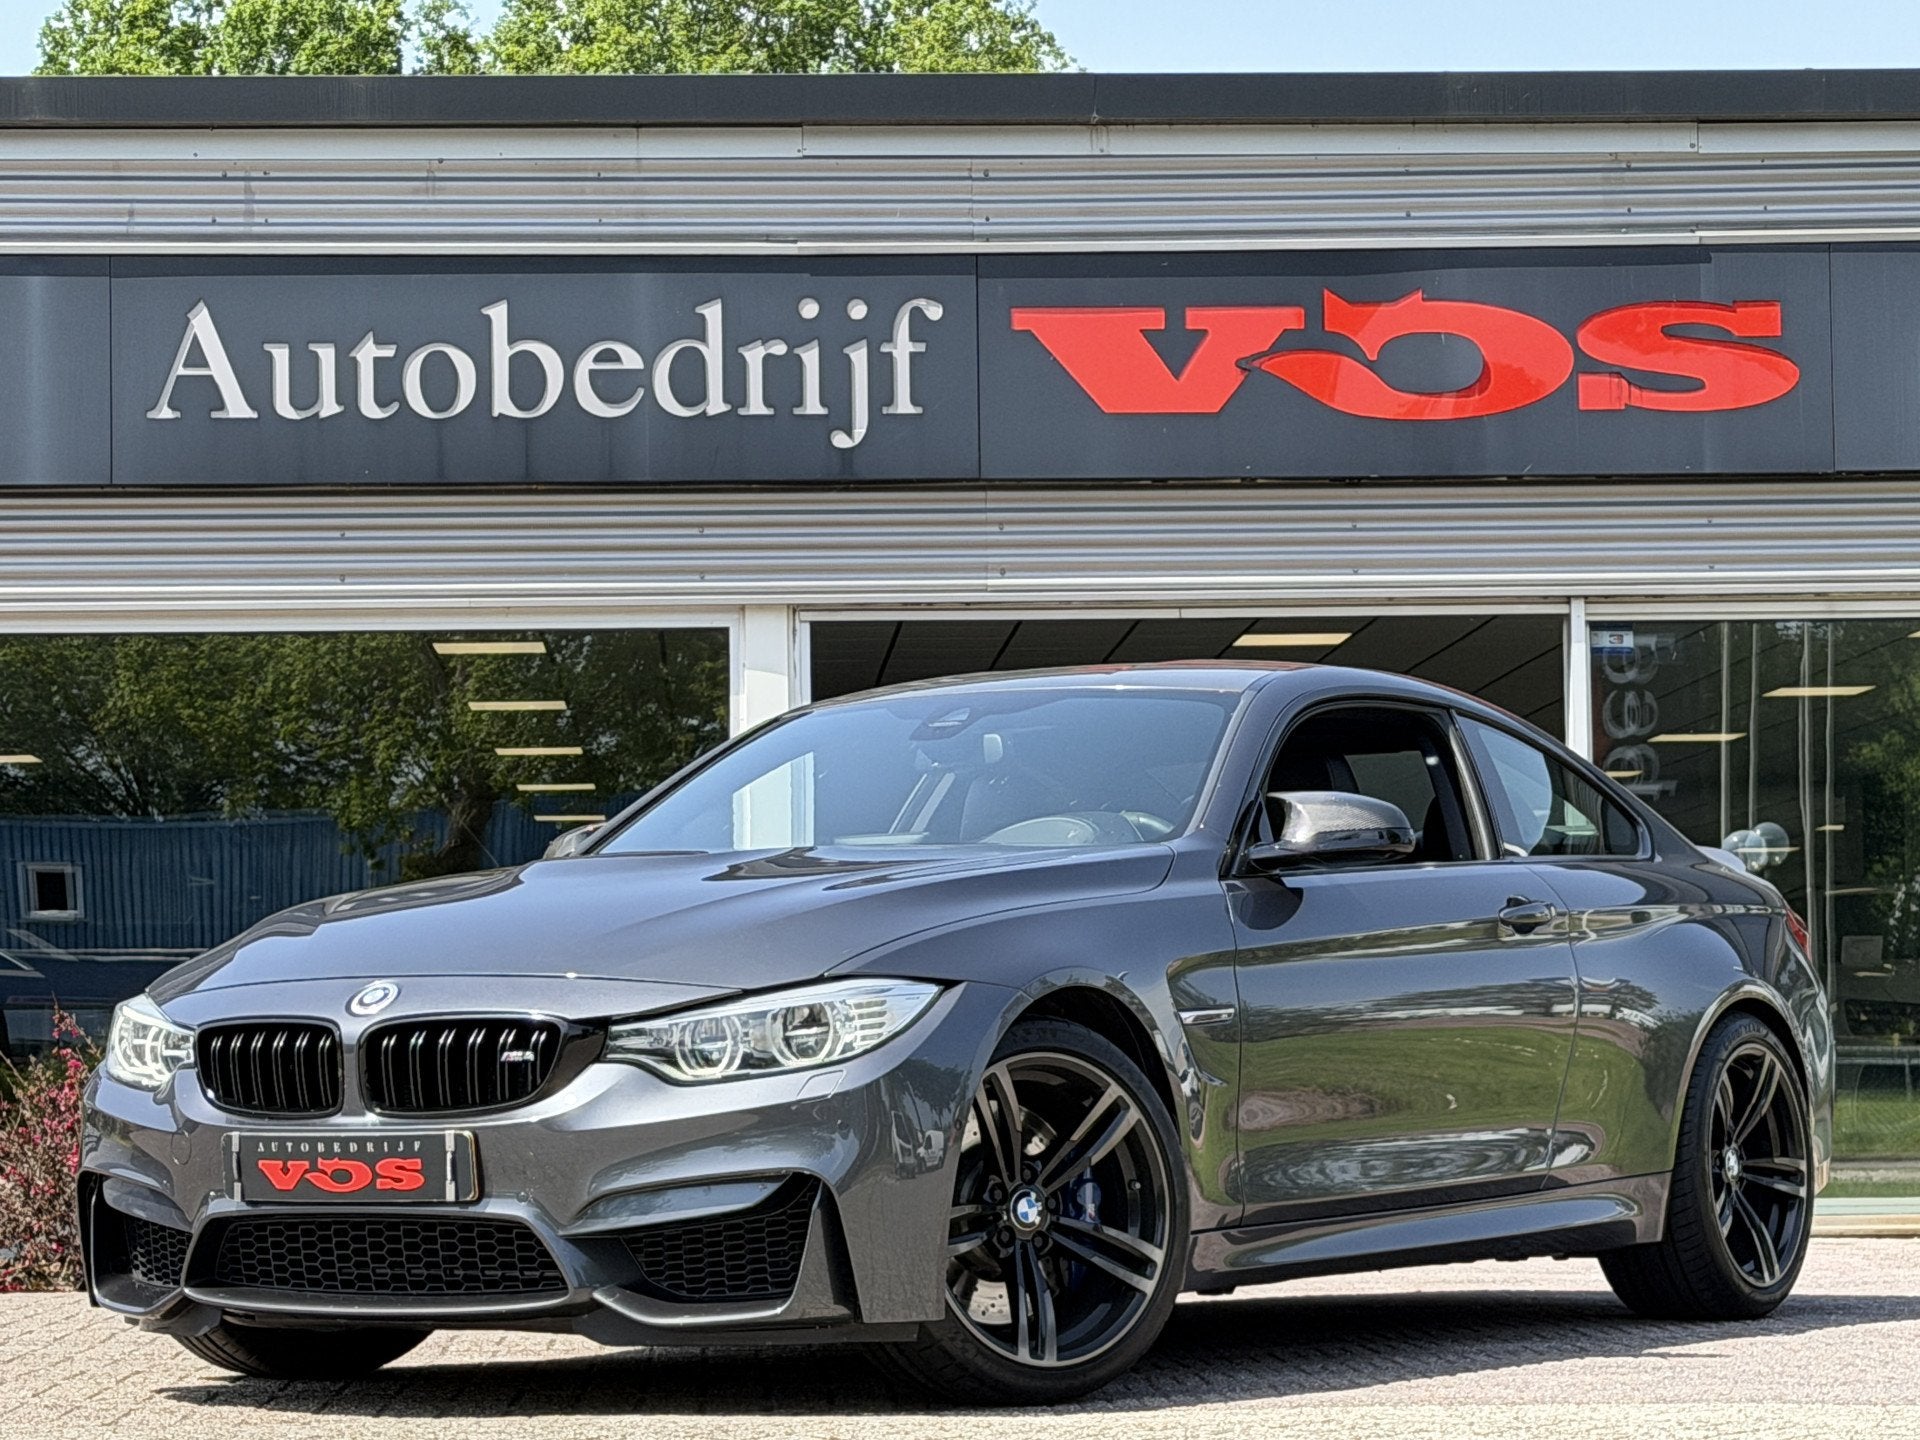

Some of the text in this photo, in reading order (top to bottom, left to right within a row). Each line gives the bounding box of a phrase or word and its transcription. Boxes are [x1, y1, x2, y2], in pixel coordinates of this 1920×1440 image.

[146, 288, 1801, 449] Autobedrijf VOS
[257, 1140, 421, 1153] AUTOBEDRIJF
[257, 1157, 426, 1193] VOS
